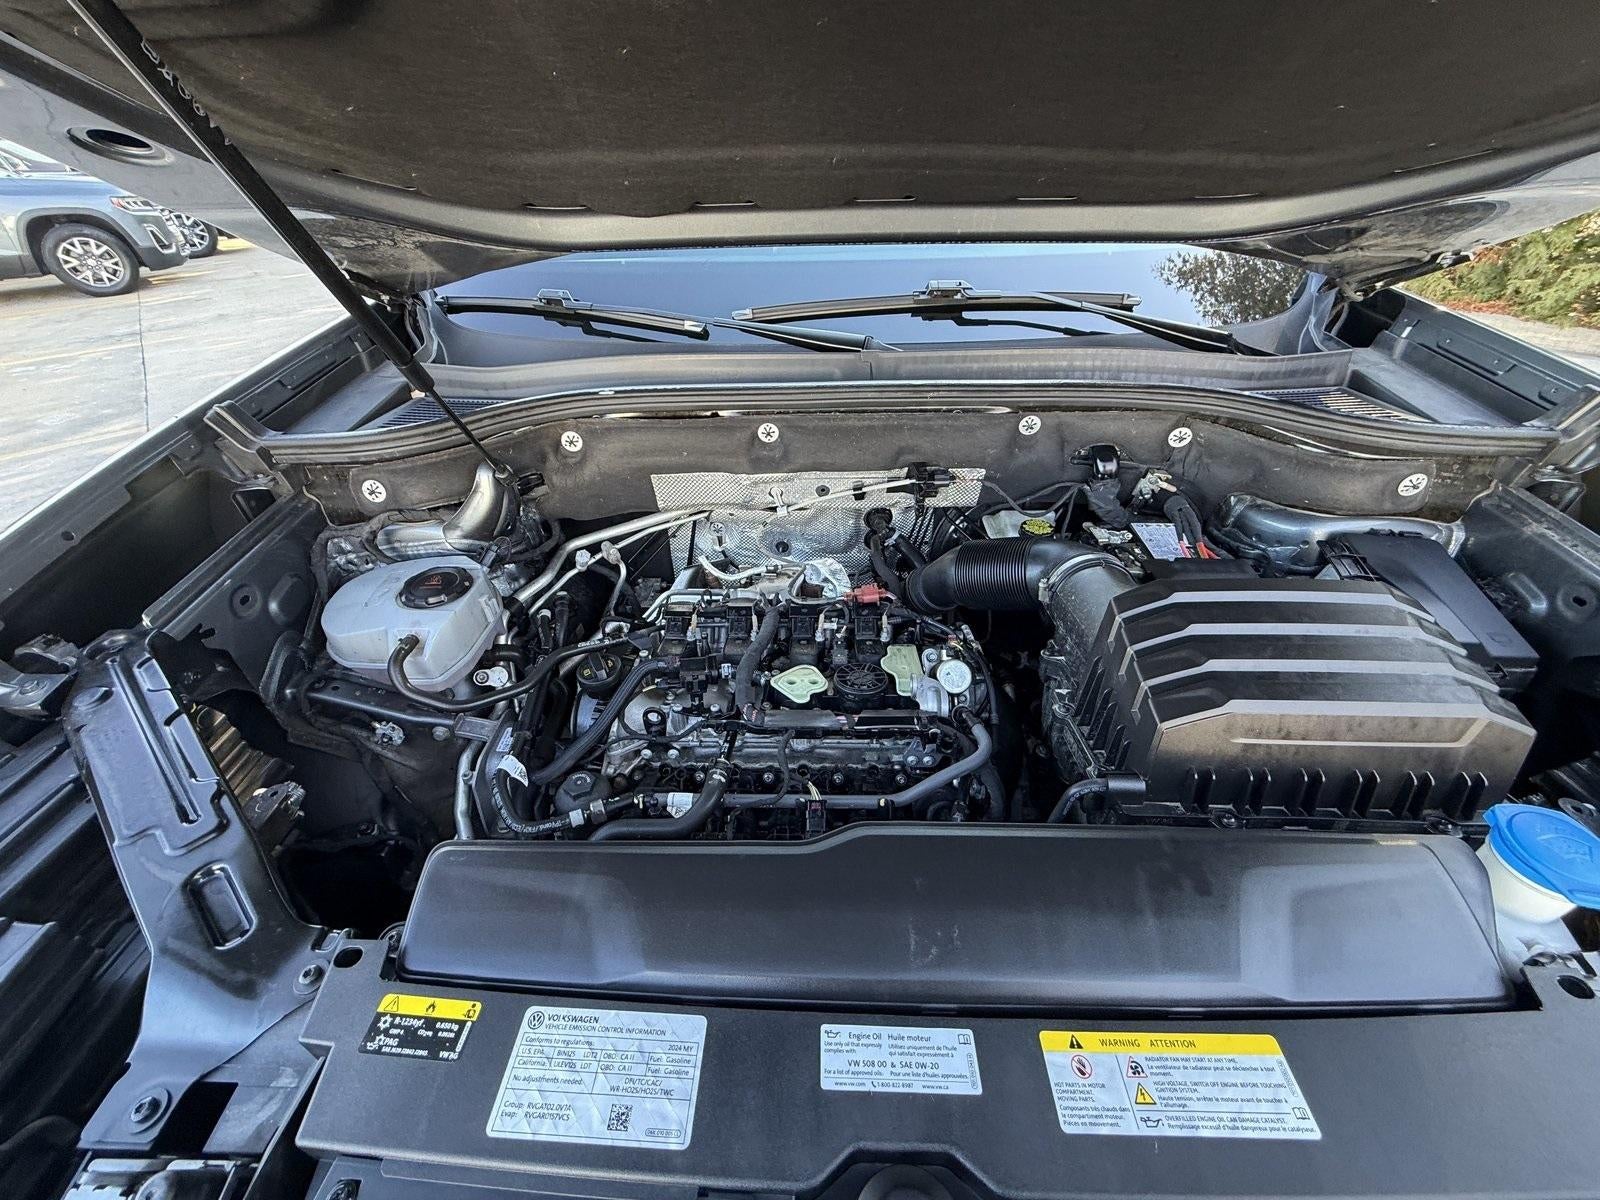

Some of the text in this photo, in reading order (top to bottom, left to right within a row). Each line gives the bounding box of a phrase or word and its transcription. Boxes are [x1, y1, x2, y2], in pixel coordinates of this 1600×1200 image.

[548, 1014, 600, 1024] VOLKSWAGEN
[598, 1025, 624, 1033] CONTROL
[625, 1027, 666, 1036] INFORMATION
[526, 1036, 552, 1044] Conforms
[848, 1032, 871, 1041] Engine
[1099, 1039, 1196, 1048] WARNING ATTENTION
[666, 1057, 691, 1065] Gasoline
[664, 1068, 689, 1077] Gasoline
[522, 1075, 559, 1085] adjustments
[504, 1100, 524, 1109] Group:
